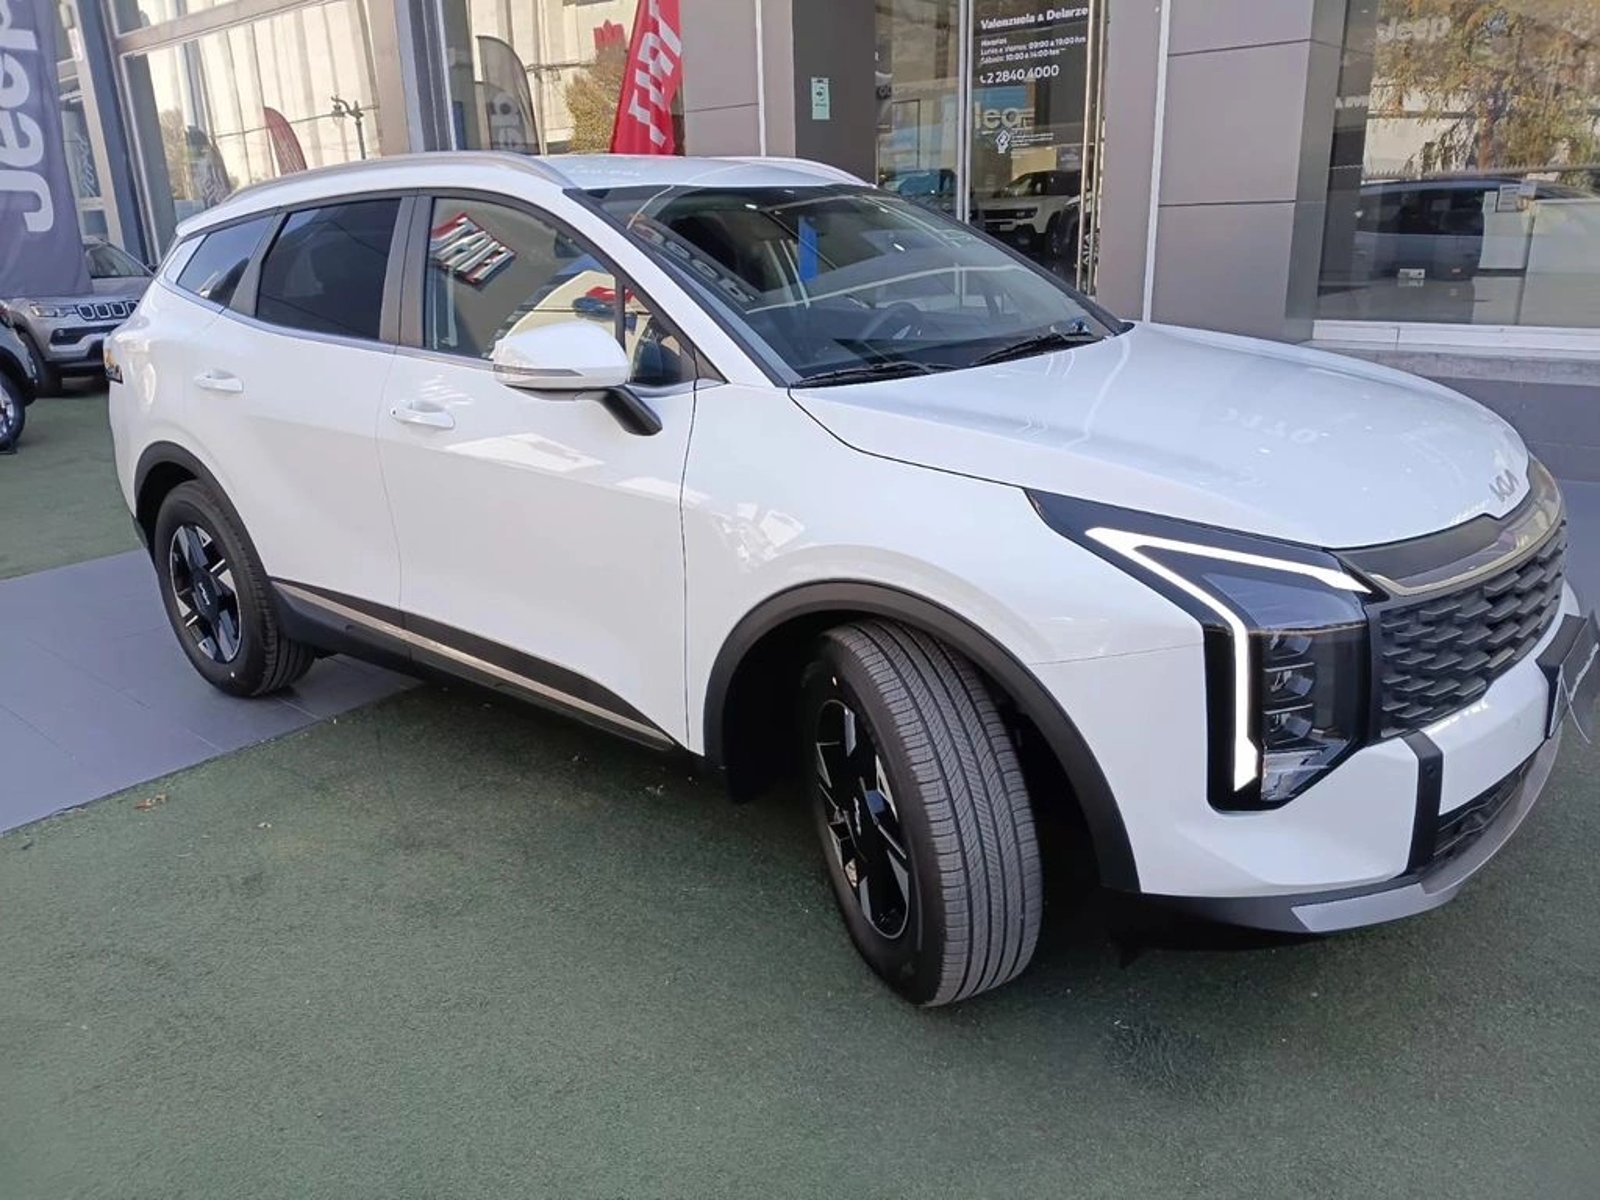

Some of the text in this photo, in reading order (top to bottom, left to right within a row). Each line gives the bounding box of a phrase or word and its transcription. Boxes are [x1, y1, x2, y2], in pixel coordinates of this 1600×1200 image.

[987, 64, 1060, 84] 2 2840 4000
